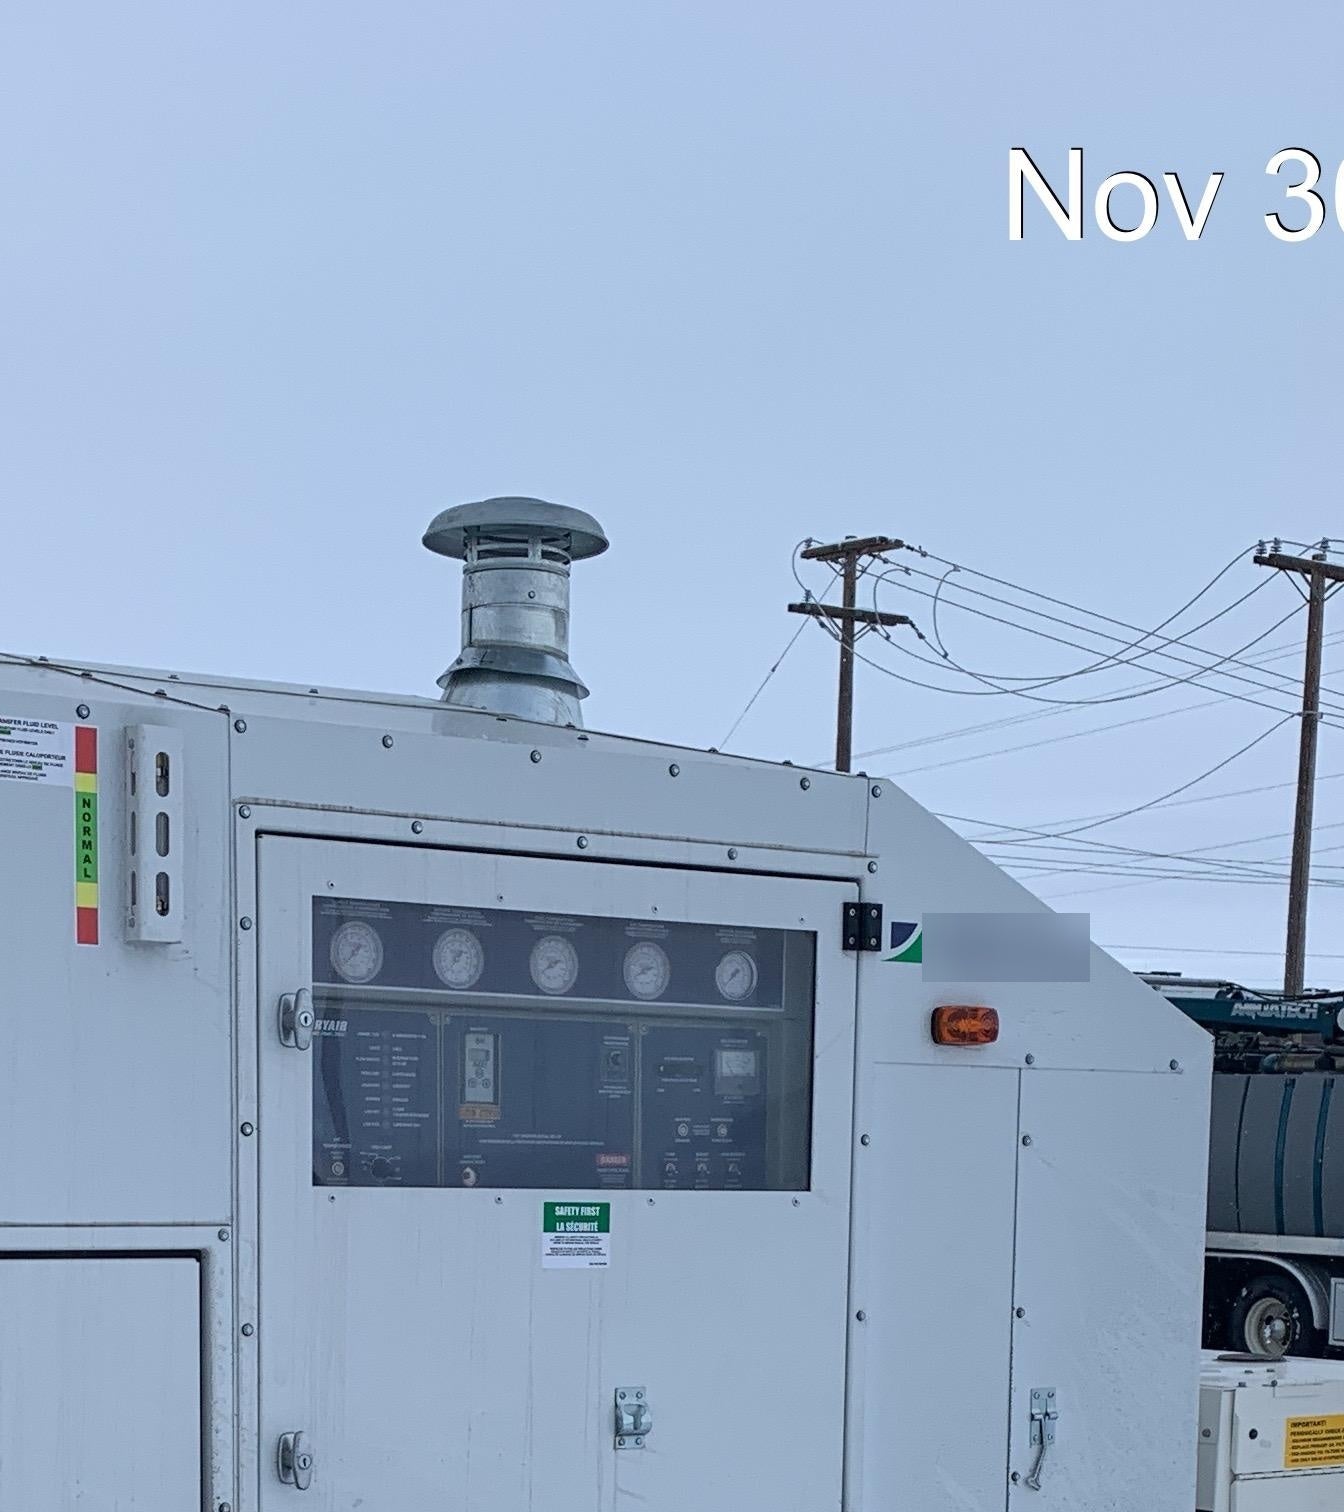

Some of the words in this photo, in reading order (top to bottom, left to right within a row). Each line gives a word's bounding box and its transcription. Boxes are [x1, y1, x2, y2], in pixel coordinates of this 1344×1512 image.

[41, 722, 59, 730] LEVEL
[81, 797, 93, 878] NORMAL
[313, 1019, 349, 1032] RYAIR
[554, 1206, 580, 1217] SAFETY
[581, 1206, 601, 1217] FIRST
[556, 1221, 565, 1232] LA
